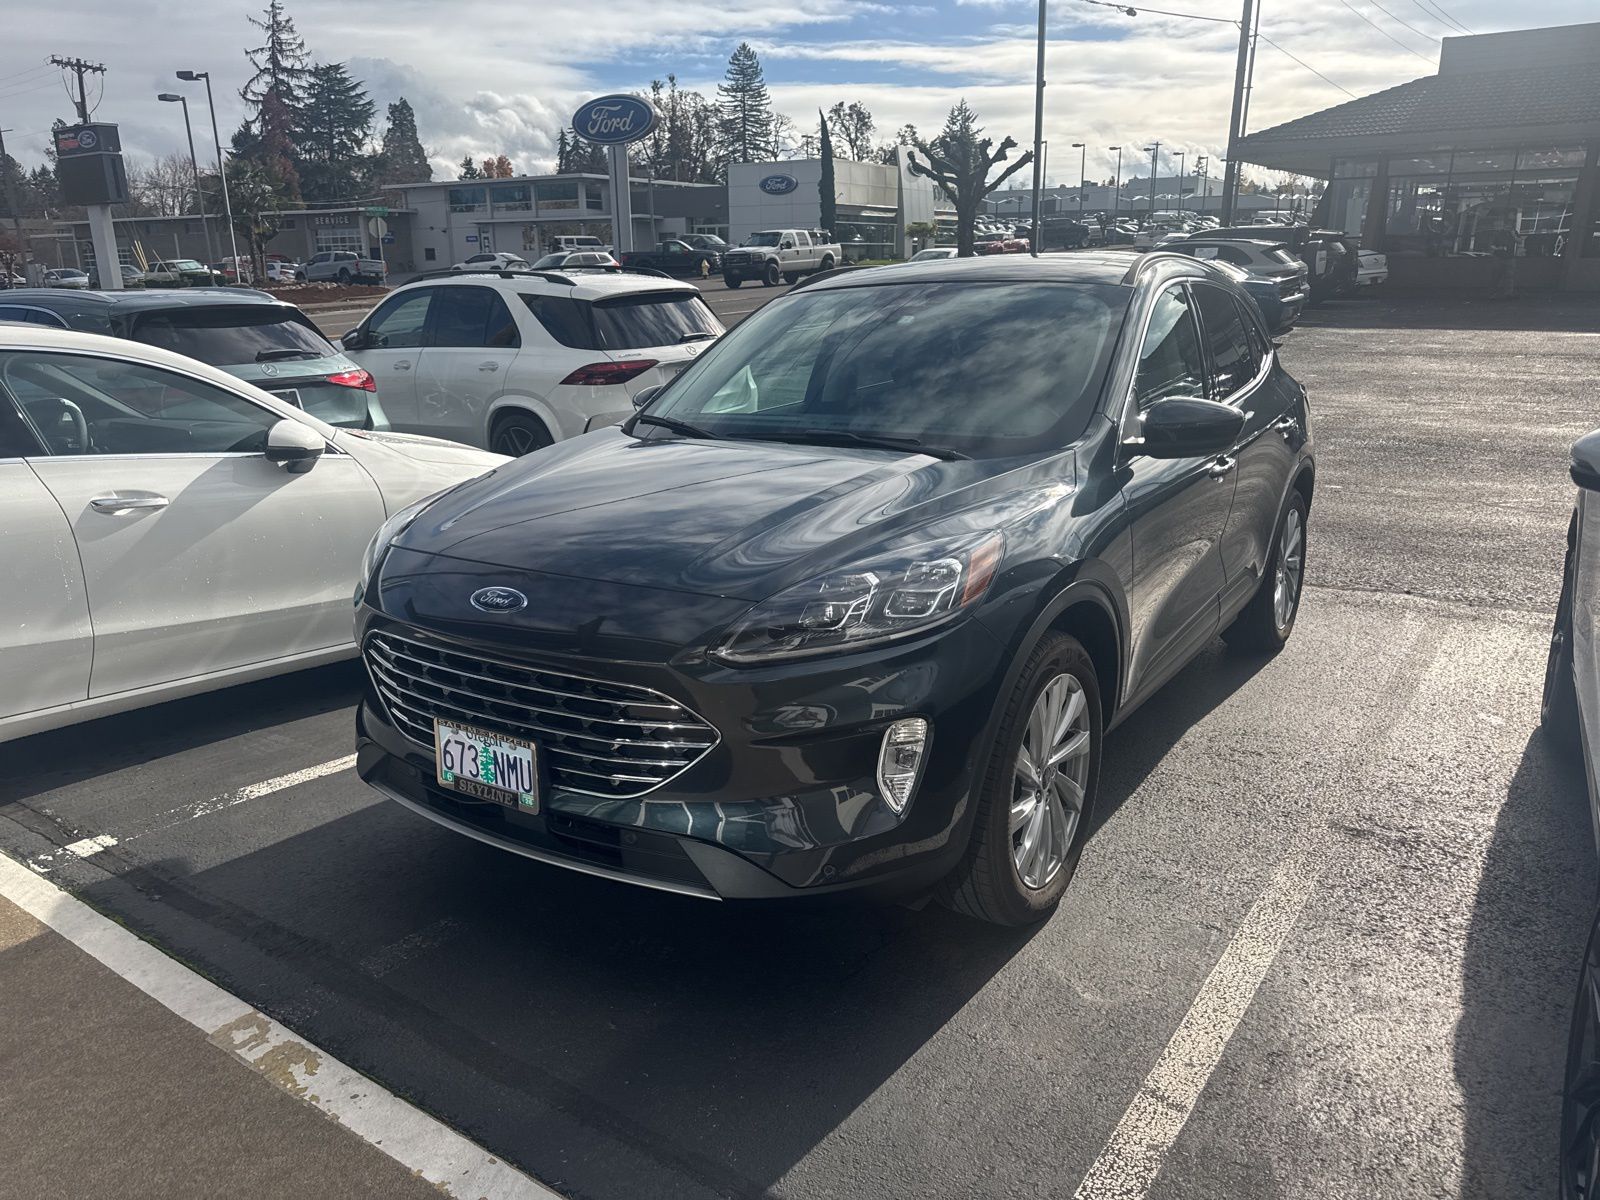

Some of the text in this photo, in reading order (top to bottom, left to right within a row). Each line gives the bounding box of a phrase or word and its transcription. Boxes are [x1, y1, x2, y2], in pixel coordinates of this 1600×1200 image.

[587, 105, 635, 134] Ford
[765, 178, 788, 190] Ford
[315, 215, 350, 225] SERVICE
[480, 590, 514, 607] Ford
[438, 720, 531, 748] SALEM KEIZER
[443, 739, 533, 793] 673 NMU
[459, 779, 513, 805] SKYLINE
